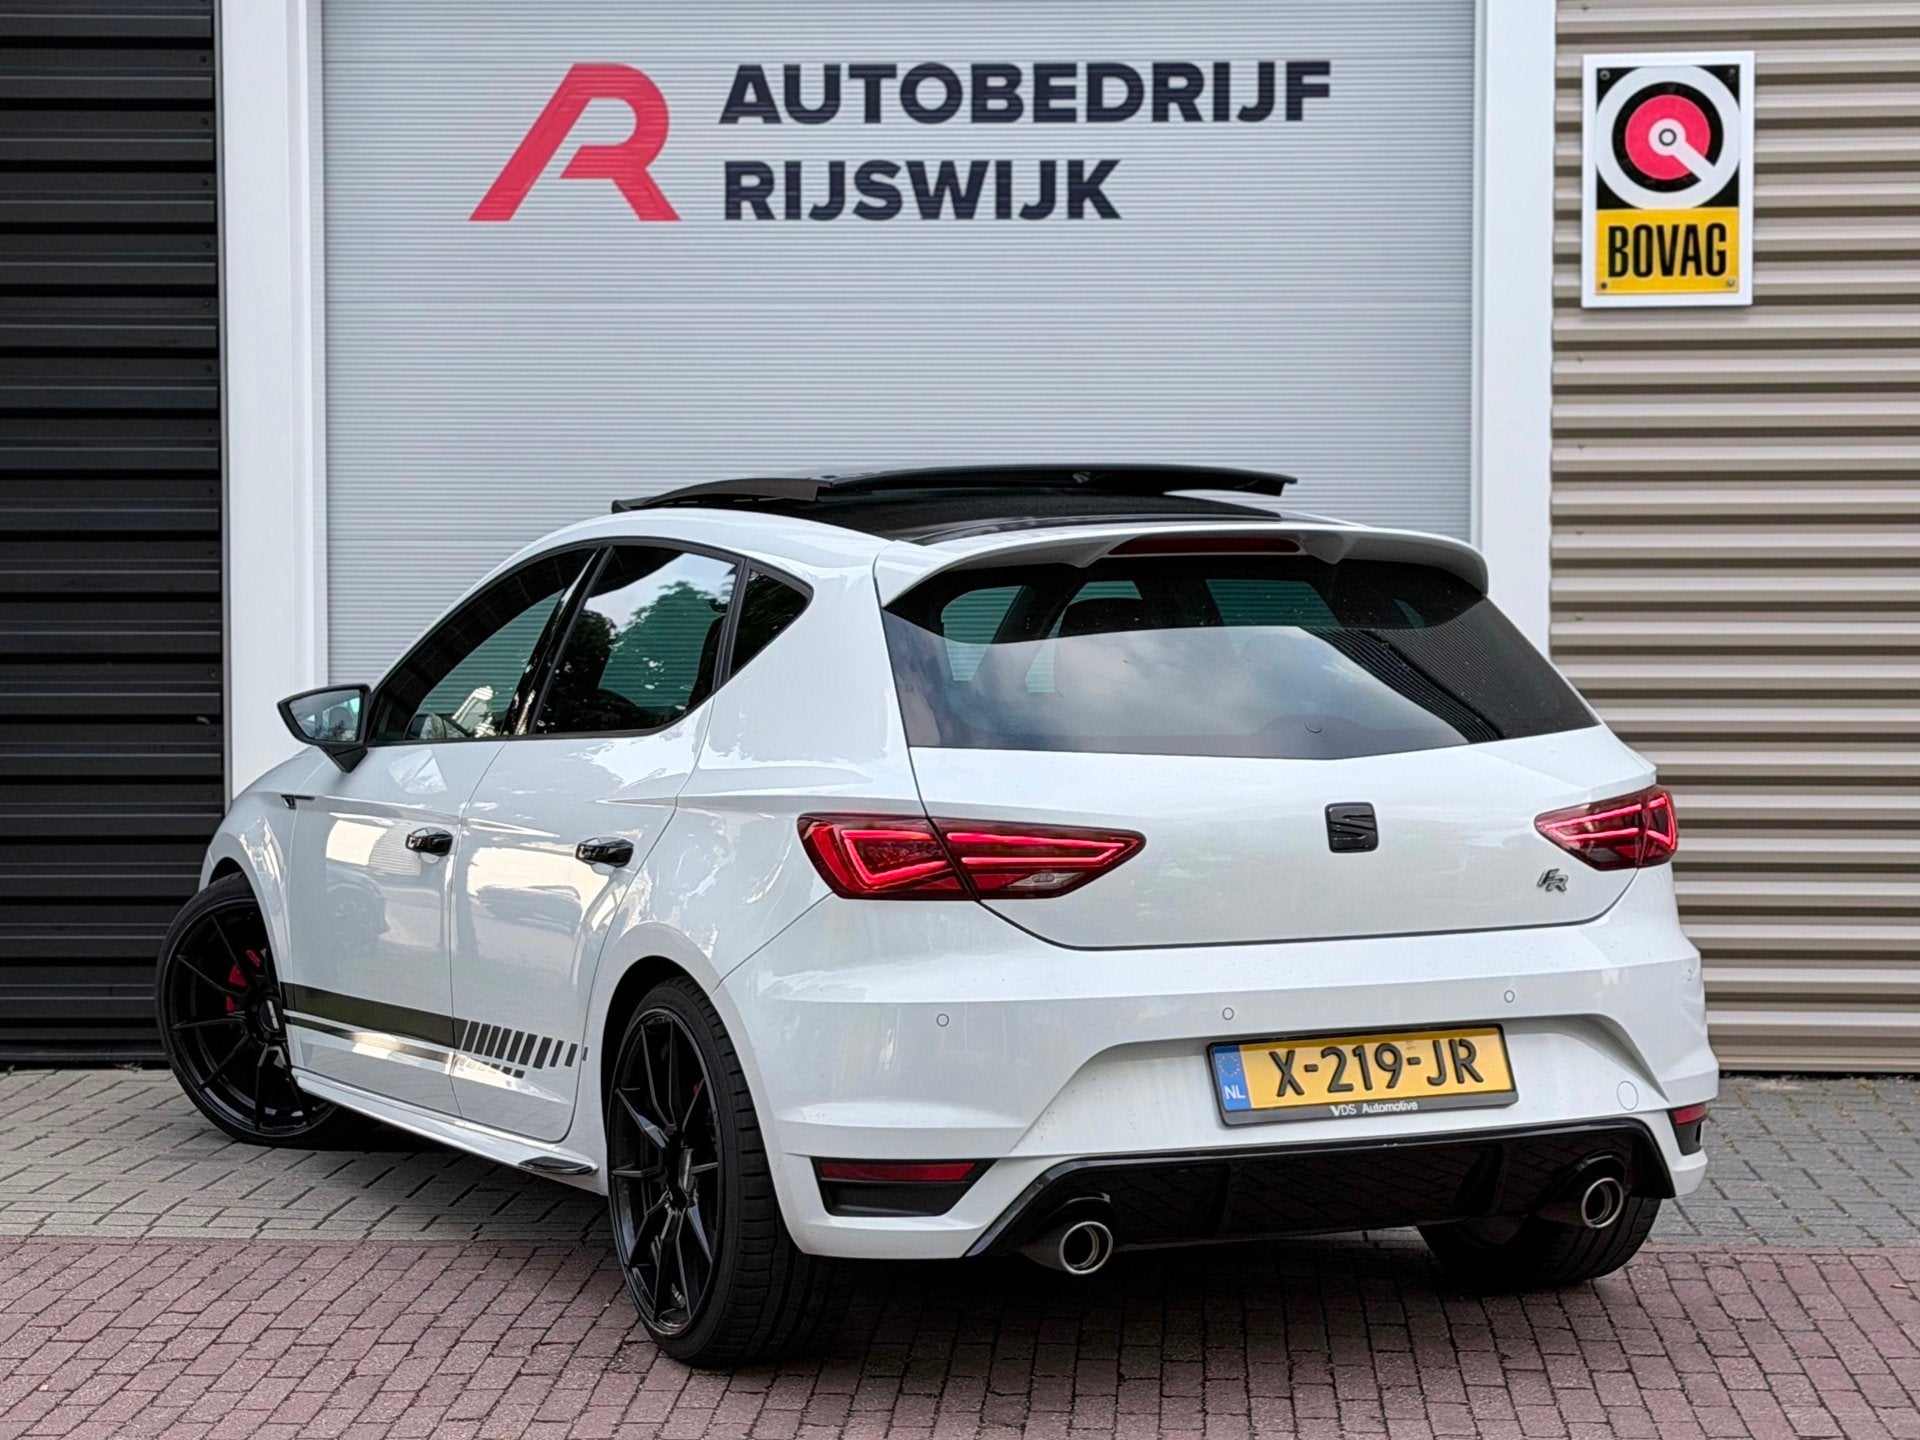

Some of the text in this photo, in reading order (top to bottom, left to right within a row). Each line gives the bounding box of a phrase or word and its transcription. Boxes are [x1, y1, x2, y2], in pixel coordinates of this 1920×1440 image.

[718, 60, 1331, 125] AUTOBEDRIJF
[724, 158, 1122, 221] RIJSWIJK
[1608, 222, 1727, 278] BOVAG
[1224, 1085, 1246, 1100] NL
[1269, 1038, 1484, 1098] X-219-JR
[1330, 1099, 1418, 1117] VDS Automotive
